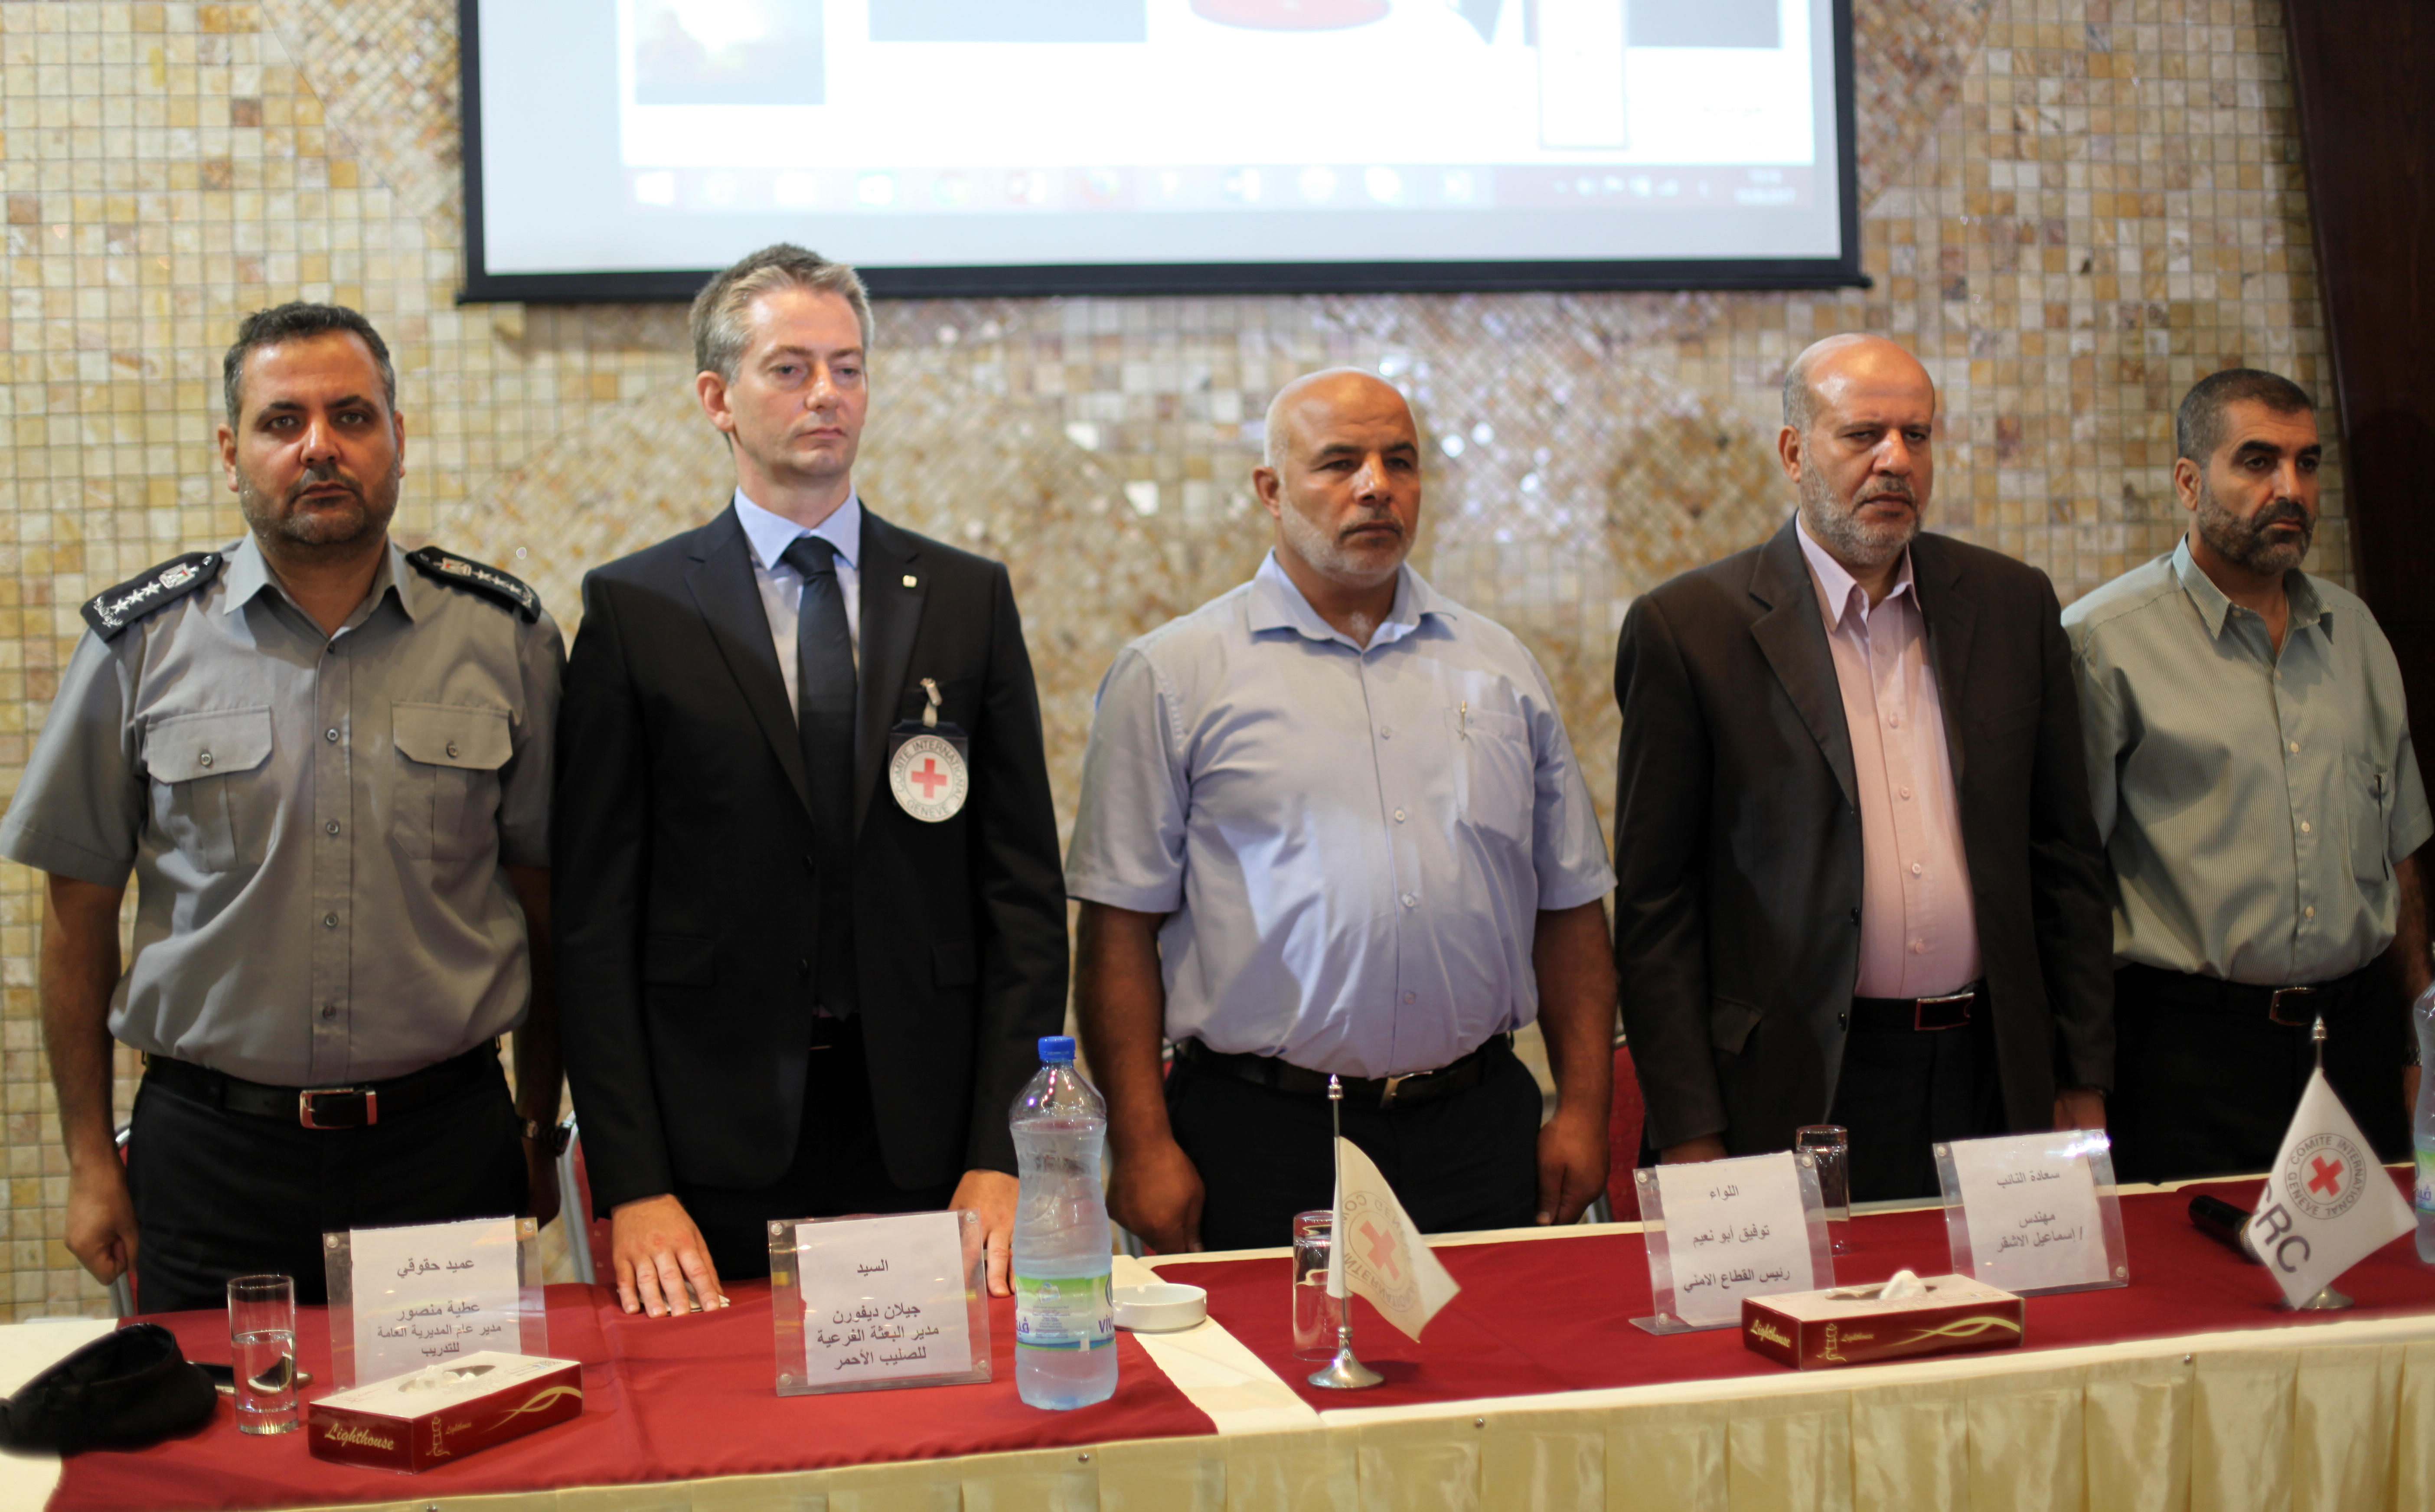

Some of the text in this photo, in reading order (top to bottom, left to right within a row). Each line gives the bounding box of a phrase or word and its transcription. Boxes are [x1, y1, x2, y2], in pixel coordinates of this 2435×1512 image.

[894, 740, 965, 800] COMITE INTERNATIONAL
[907, 800, 949, 816] GENEVE
[2291, 1136, 2363, 1216] COMITE INTERNATIONAL
[1710, 1185, 1739, 1201] اللواء
[2288, 1172, 2320, 1216] GENEVE
[2019, 1211, 2056, 1228] مهندس
[1693, 1230, 1714, 1248] نعيم
[1739, 1223, 1770, 1243] توفيق
[397, 1257, 474, 1279] عميد حقوقي
[857, 1259, 888, 1277] السيد
[1759, 1267, 1790, 1283] رئيس
[1721, 1269, 1754, 1290] القطاع
[396, 1300, 480, 1322] عطية منصور
[832, 1302, 921, 1324] جيلان ديفورن
[377, 1324, 502, 1339] مدير عام المديرية العامة
[817, 1325, 939, 1348] مدير البعثة الفرعية
[1750, 1319, 1791, 1348] Lighthouse
[421, 1342, 460, 1357] للتدريب
[834, 1346, 927, 1370] للصليب الأحمر
[324, 1422, 394, 1450] Lighthouse
